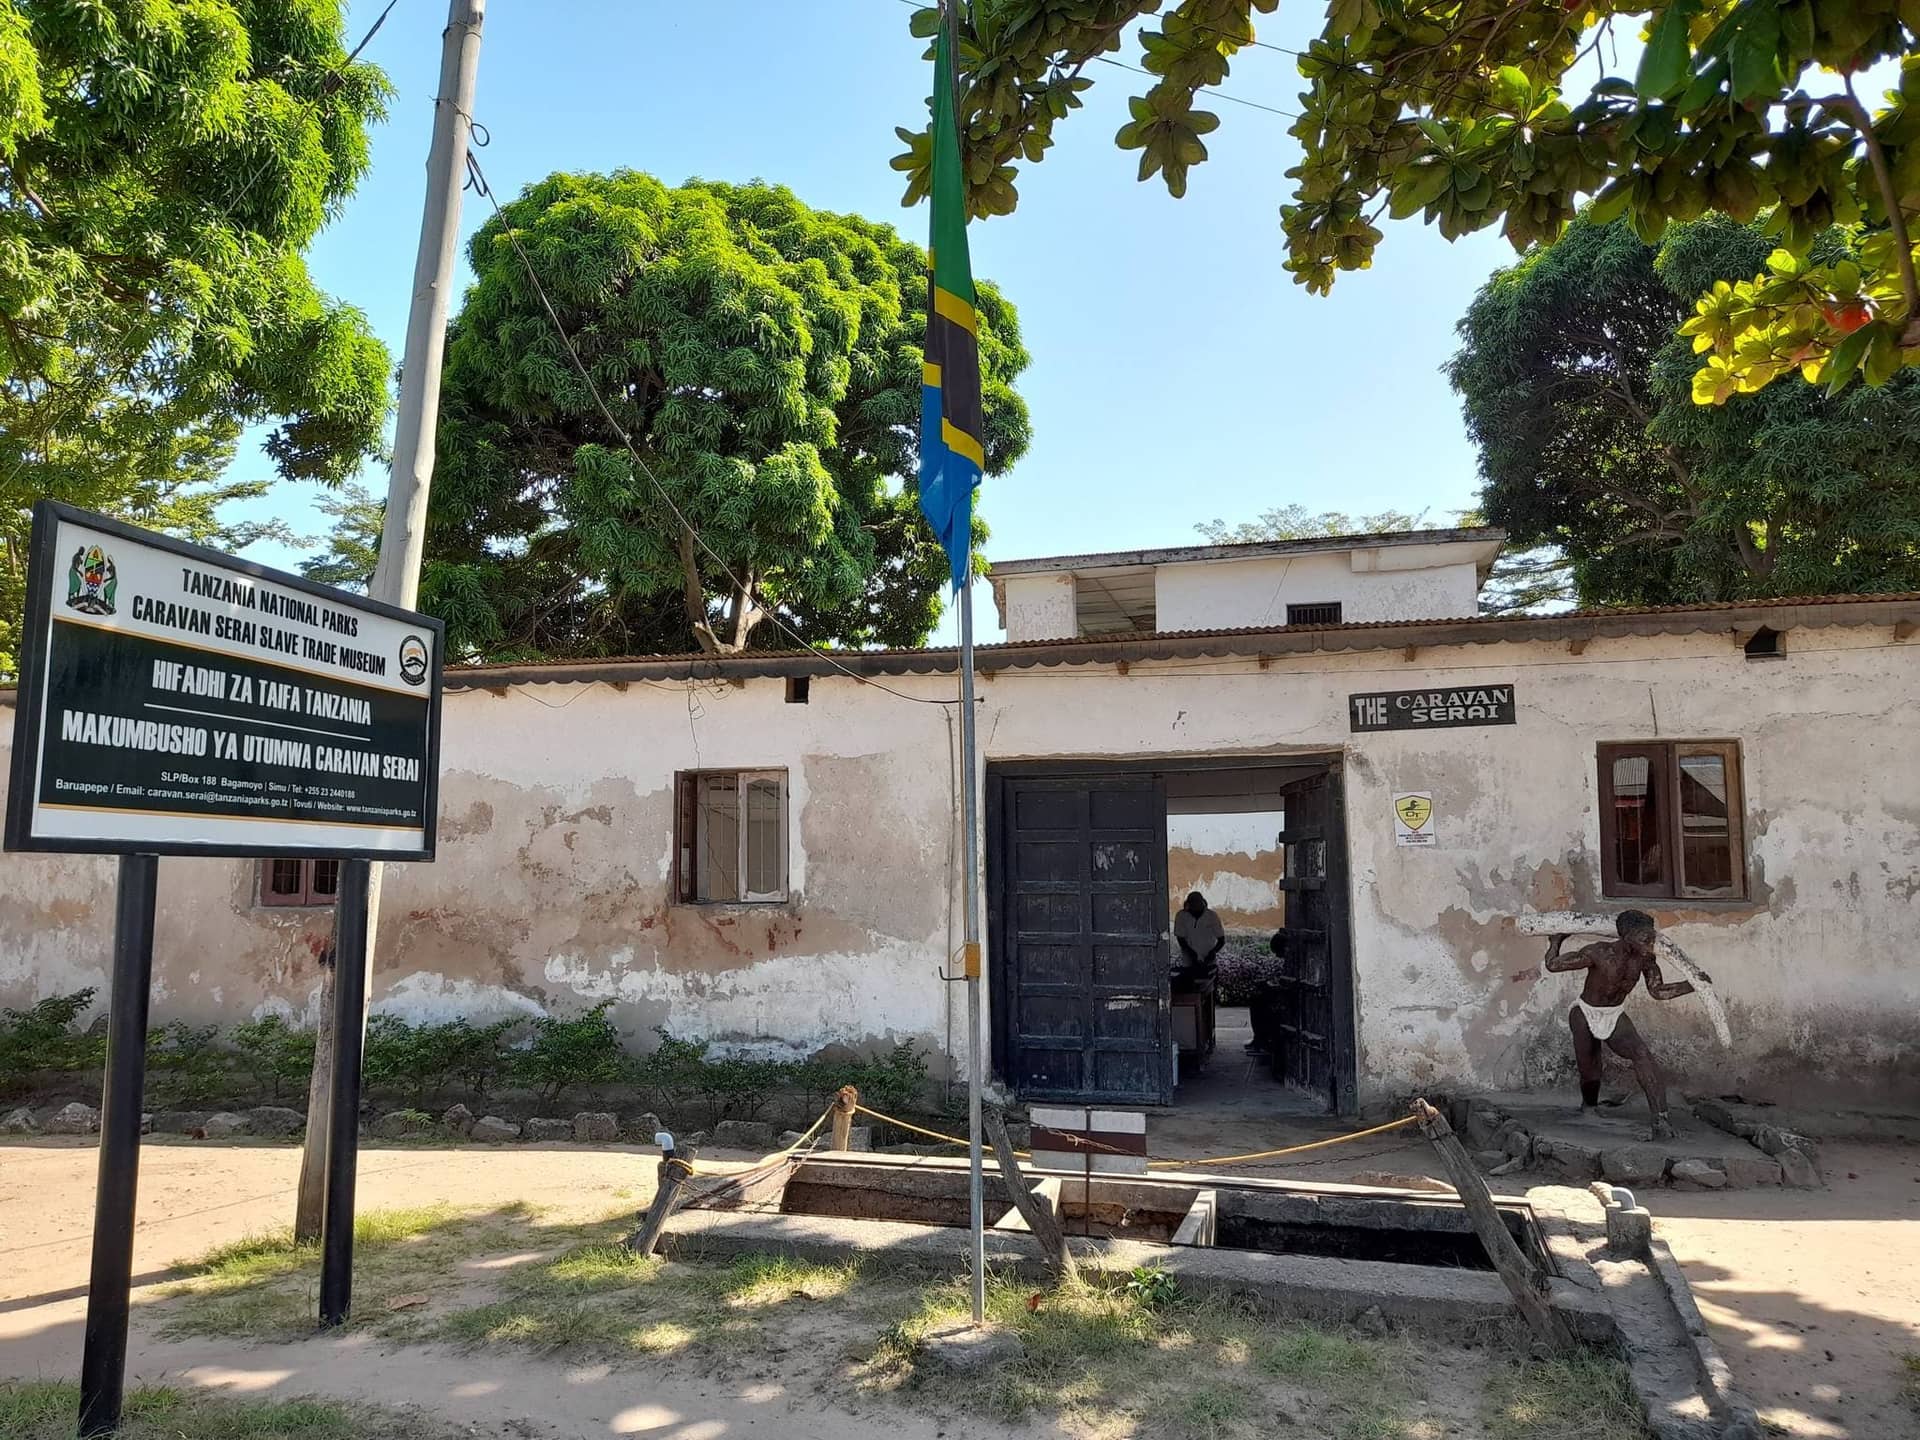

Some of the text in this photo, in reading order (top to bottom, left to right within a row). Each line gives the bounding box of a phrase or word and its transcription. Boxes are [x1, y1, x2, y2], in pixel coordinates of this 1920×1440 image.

[182, 567, 358, 638] TANZANIA NATIONAL PARKS
[132, 594, 386, 677] CARAVAN SERAI SLAVE TRADE MUSEUM
[152, 659, 371, 726] HIFADHI ZA TAIFA TANZANIA
[1355, 688, 1510, 726] THE CARAVAN
[1411, 705, 1499, 723] SERAI
[61, 709, 420, 783] MAKUMBUSHO YA UTUMWA CARAVAN SERAI
[55, 778, 109, 795] Baruapepe
[116, 784, 145, 796] Email:
[293, 798, 313, 809] Tovuti
[317, 801, 345, 812] Website:
[161, 771, 199, 785] SLP/Box
[202, 775, 217, 786] 188
[221, 777, 263, 790] Bagamoyo
[268, 781, 286, 792] Simu
[304, 786, 320, 796] +255
[321, 787, 329, 796] 23
